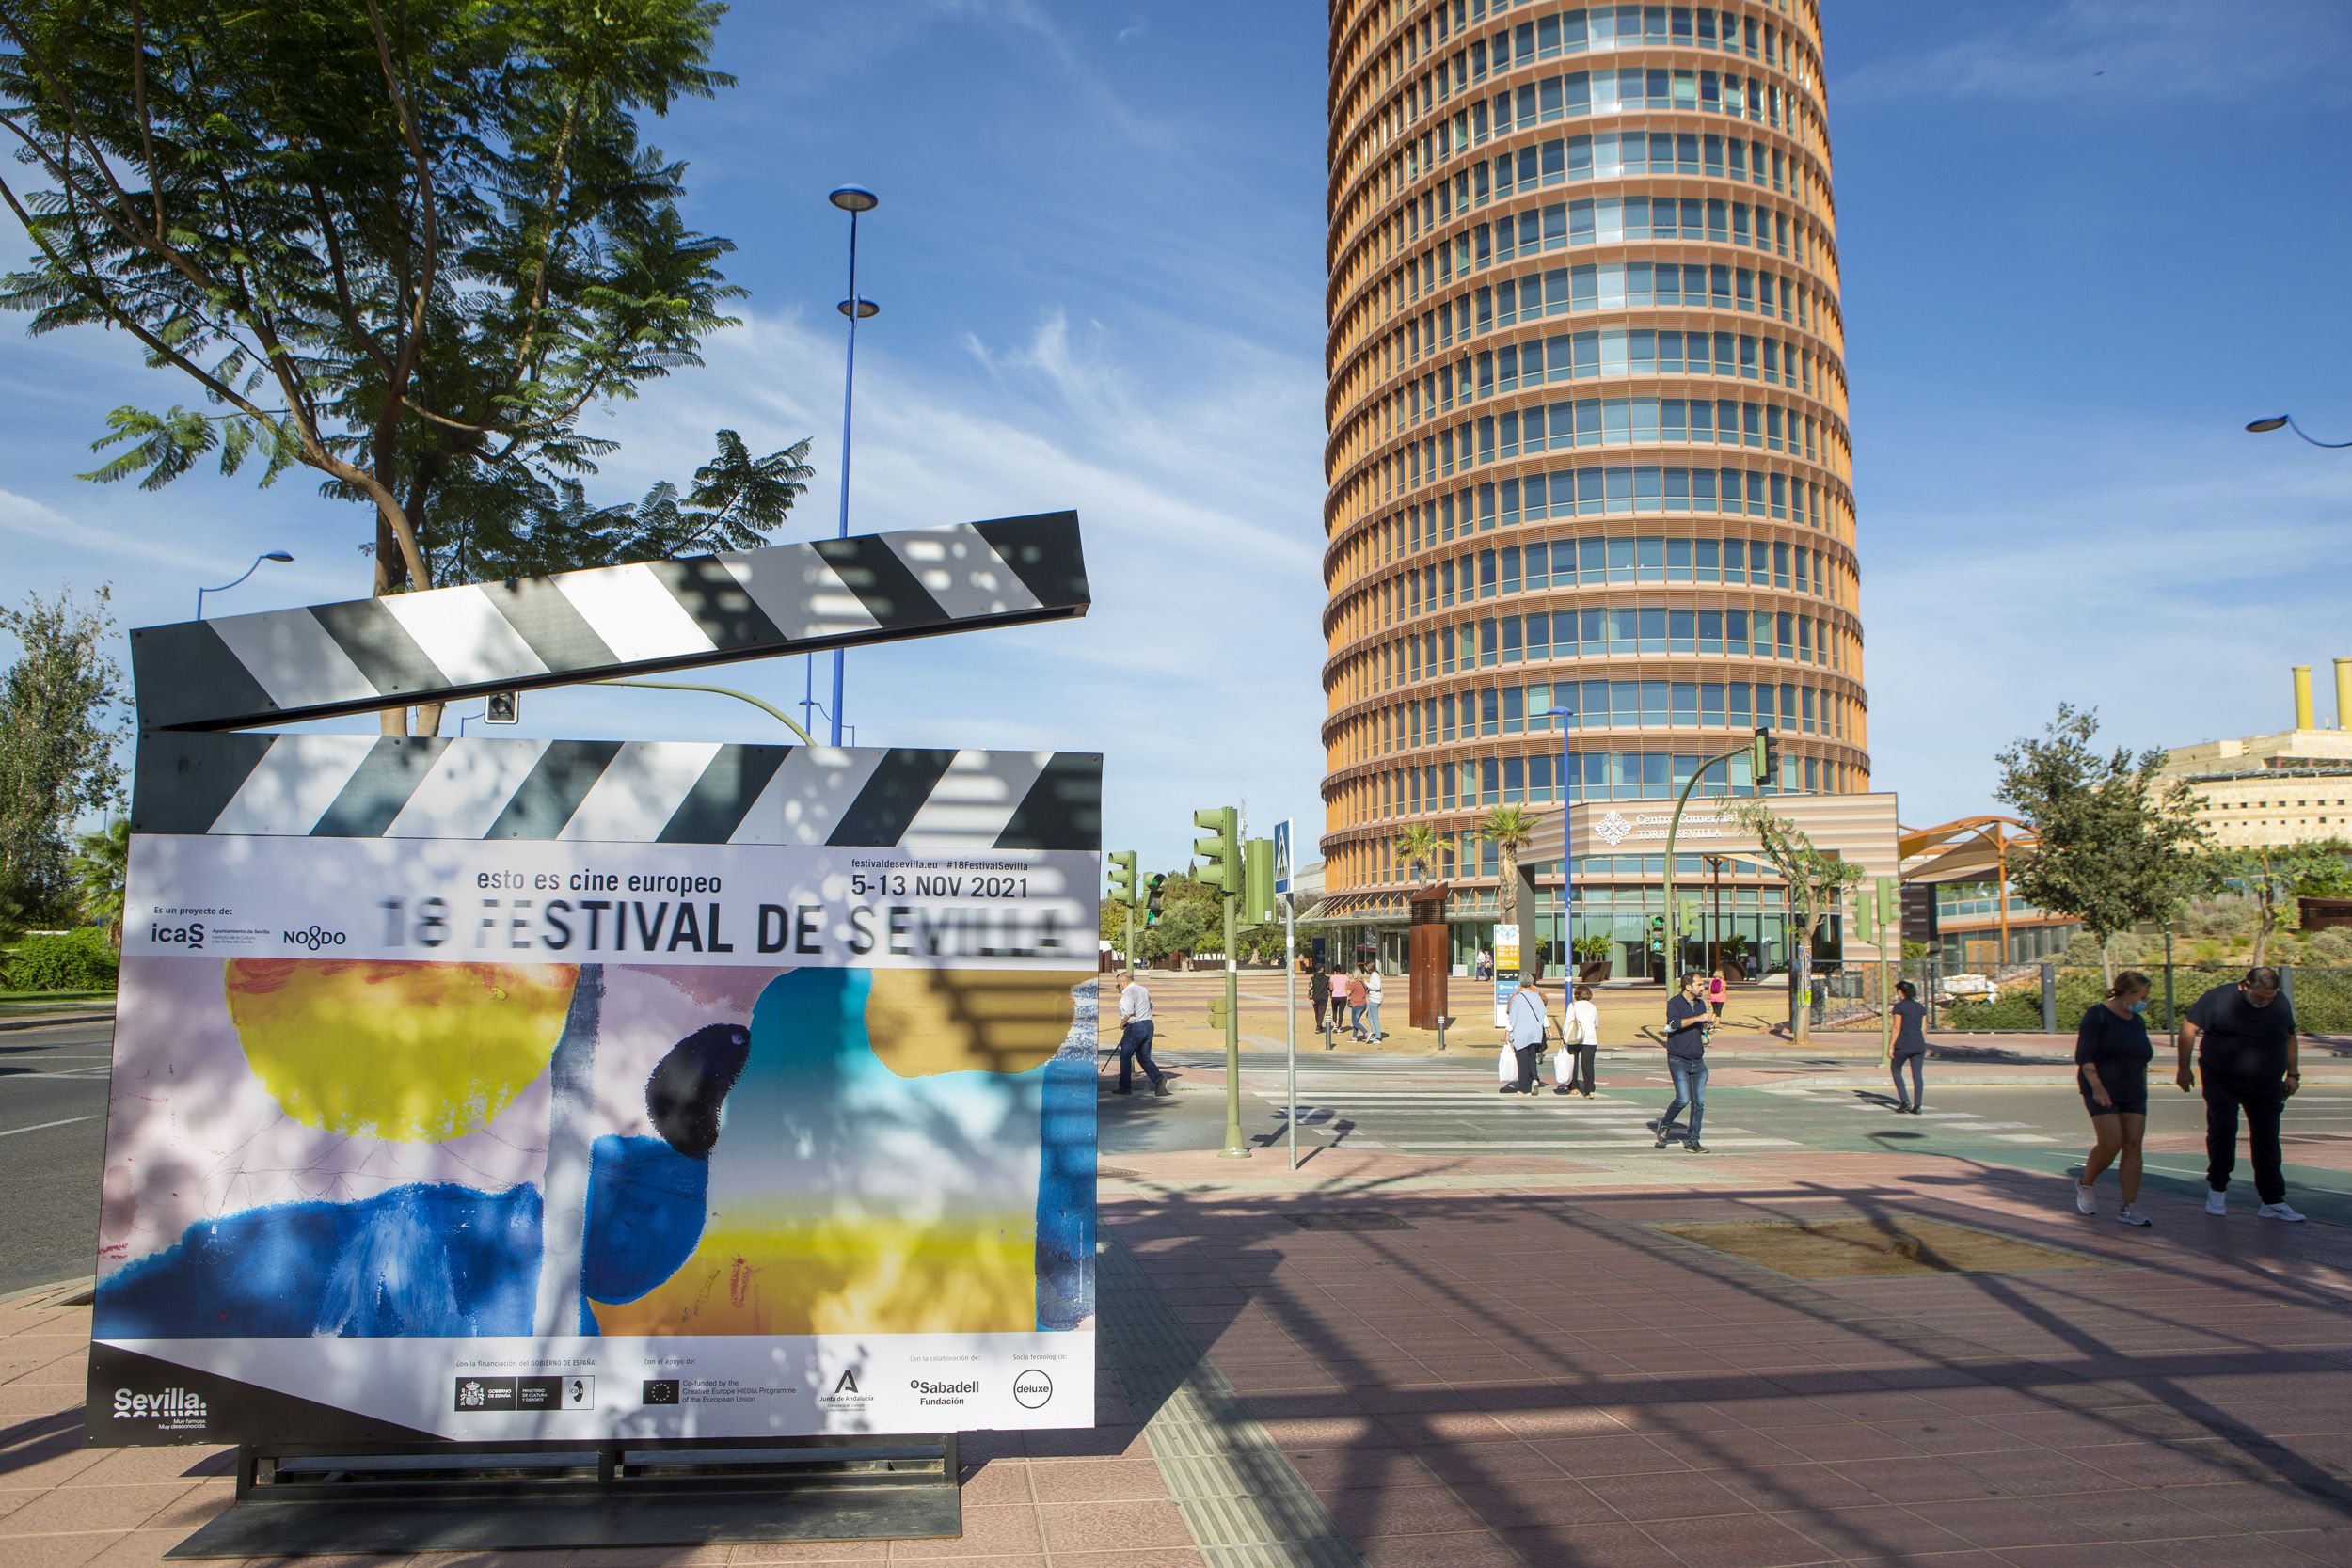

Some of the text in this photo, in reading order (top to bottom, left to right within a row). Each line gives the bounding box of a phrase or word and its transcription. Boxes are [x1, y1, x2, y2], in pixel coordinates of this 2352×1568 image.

[1679, 812, 1739, 824] Comercial
[1676, 828, 1722, 838] SEVILLA
[851, 859, 1028, 871] festivaldesevilla.eu #18FestivalSevilla
[477, 868, 722, 897] esto es cine europeo
[851, 874, 1027, 898] 5-13 NOV 2021
[154, 906, 163, 914] Es
[180, 907, 216, 916] proyecto
[219, 907, 233, 915] de:
[379, 895, 1065, 957] 18 FESTIVAL DE SEVILLA
[572, 1358, 597, 1367] ESPAÑA:
[1030, 1354, 1067, 1362] tecnológico:
[718, 1380, 727, 1388] by
[920, 1381, 979, 1394] Sabadell
[1016, 1384, 1049, 1393] deluxe
[758, 1387, 797, 1396] Programme
[114, 1387, 207, 1411] Sevilla.
[703, 1396, 735, 1404] European
[920, 1396, 964, 1406] Fundación
